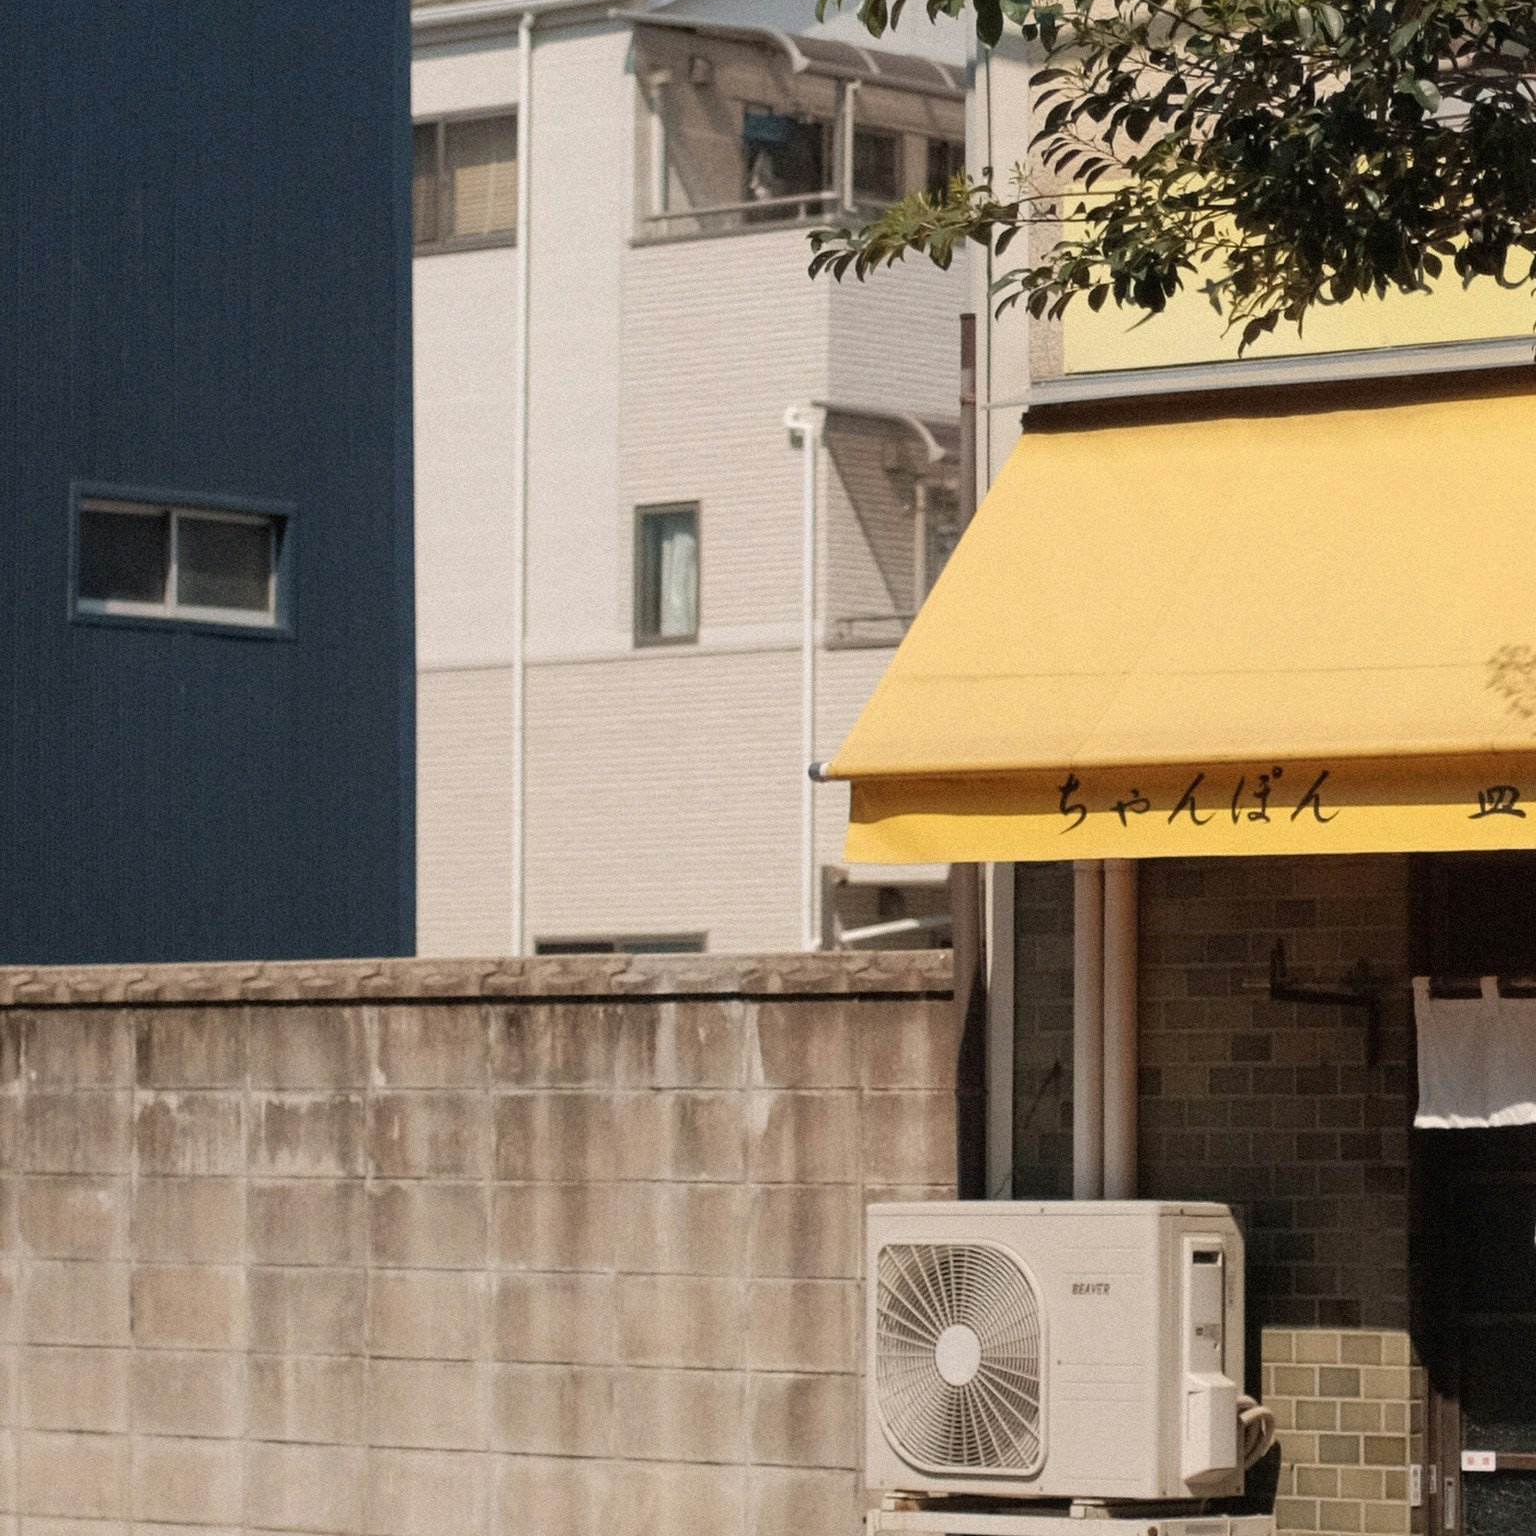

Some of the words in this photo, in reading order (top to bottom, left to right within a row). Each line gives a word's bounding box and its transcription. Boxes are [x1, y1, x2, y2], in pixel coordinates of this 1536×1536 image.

[1057, 765, 1341, 834] ちゃんぽん
[1071, 1282, 1111, 1296] BEAVER
